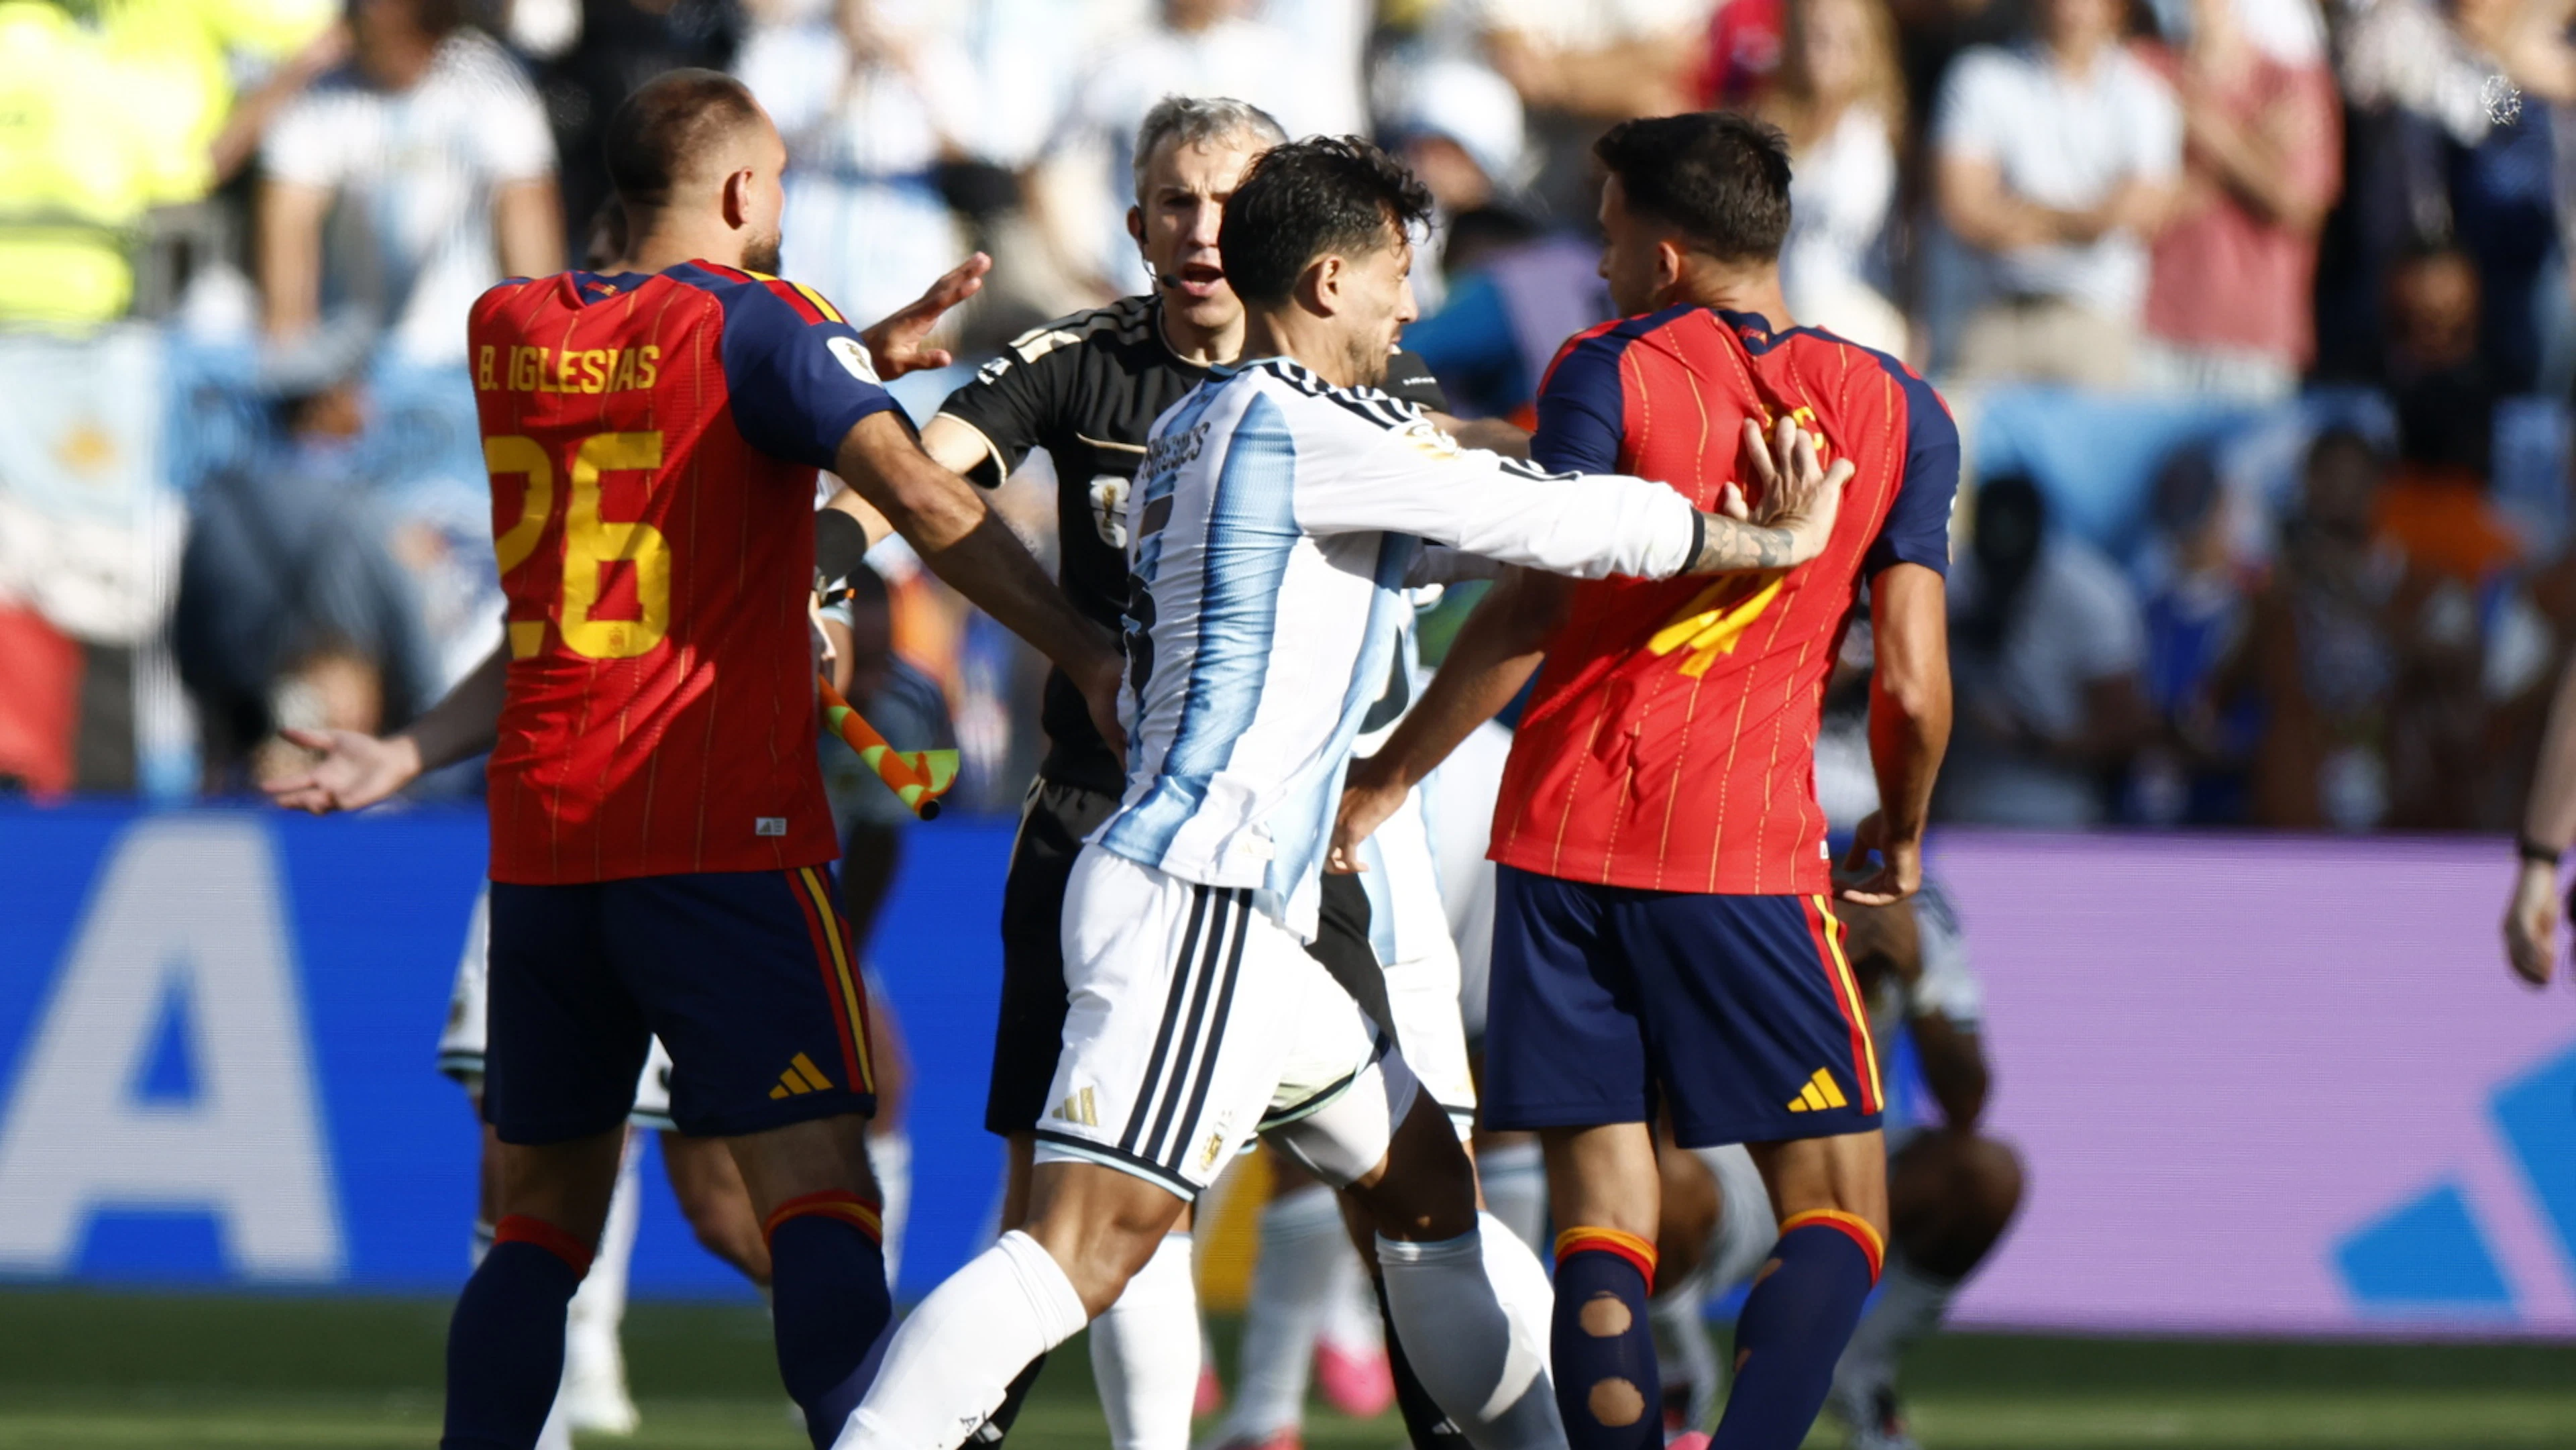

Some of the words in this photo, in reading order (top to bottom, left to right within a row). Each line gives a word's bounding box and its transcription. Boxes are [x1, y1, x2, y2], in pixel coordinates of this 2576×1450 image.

[479, 344, 498, 391] B.
[507, 344, 661, 394] IGLESIAS
[484, 430, 670, 659] 26
